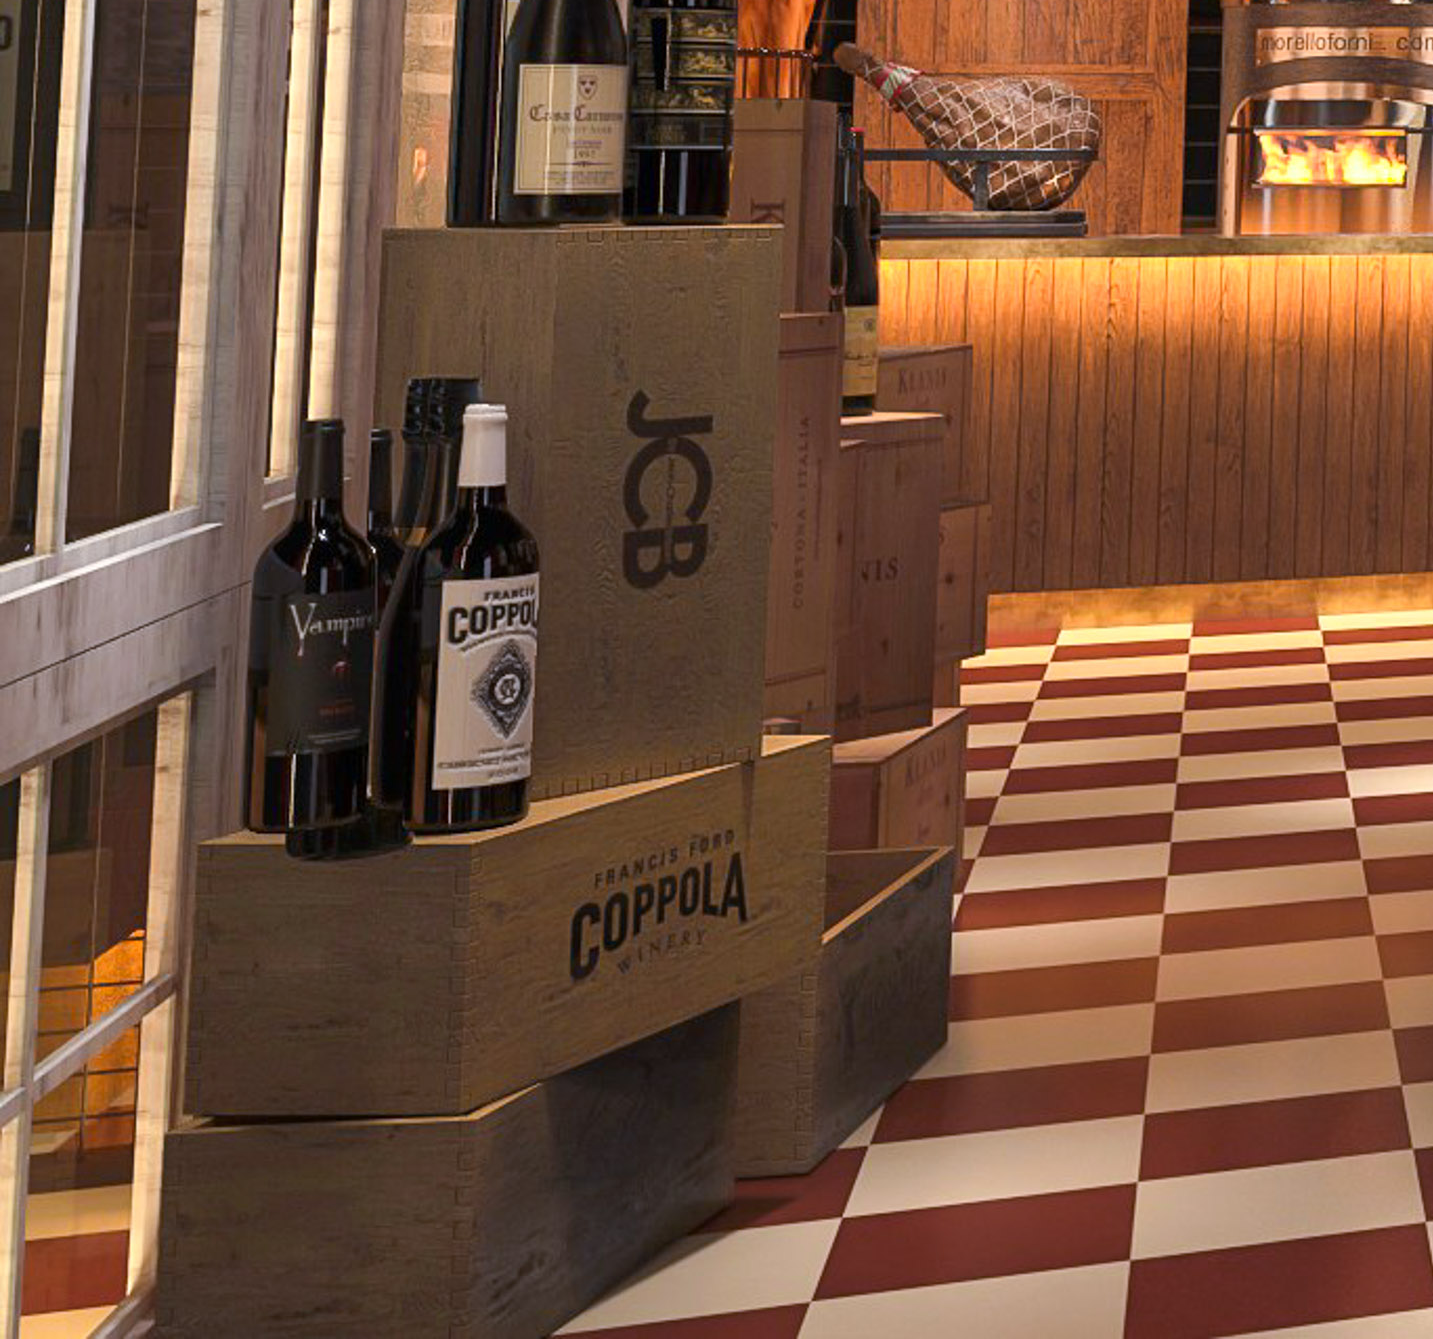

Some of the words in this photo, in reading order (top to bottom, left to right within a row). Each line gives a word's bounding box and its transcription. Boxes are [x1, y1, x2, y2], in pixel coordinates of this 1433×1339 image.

[621, 390, 713, 590] JCB
[593, 847, 679, 888] FRANCIS
[689, 828, 736, 858] FORD
[570, 851, 749, 981] COPPOLA
[616, 929, 706, 975] WINERY
